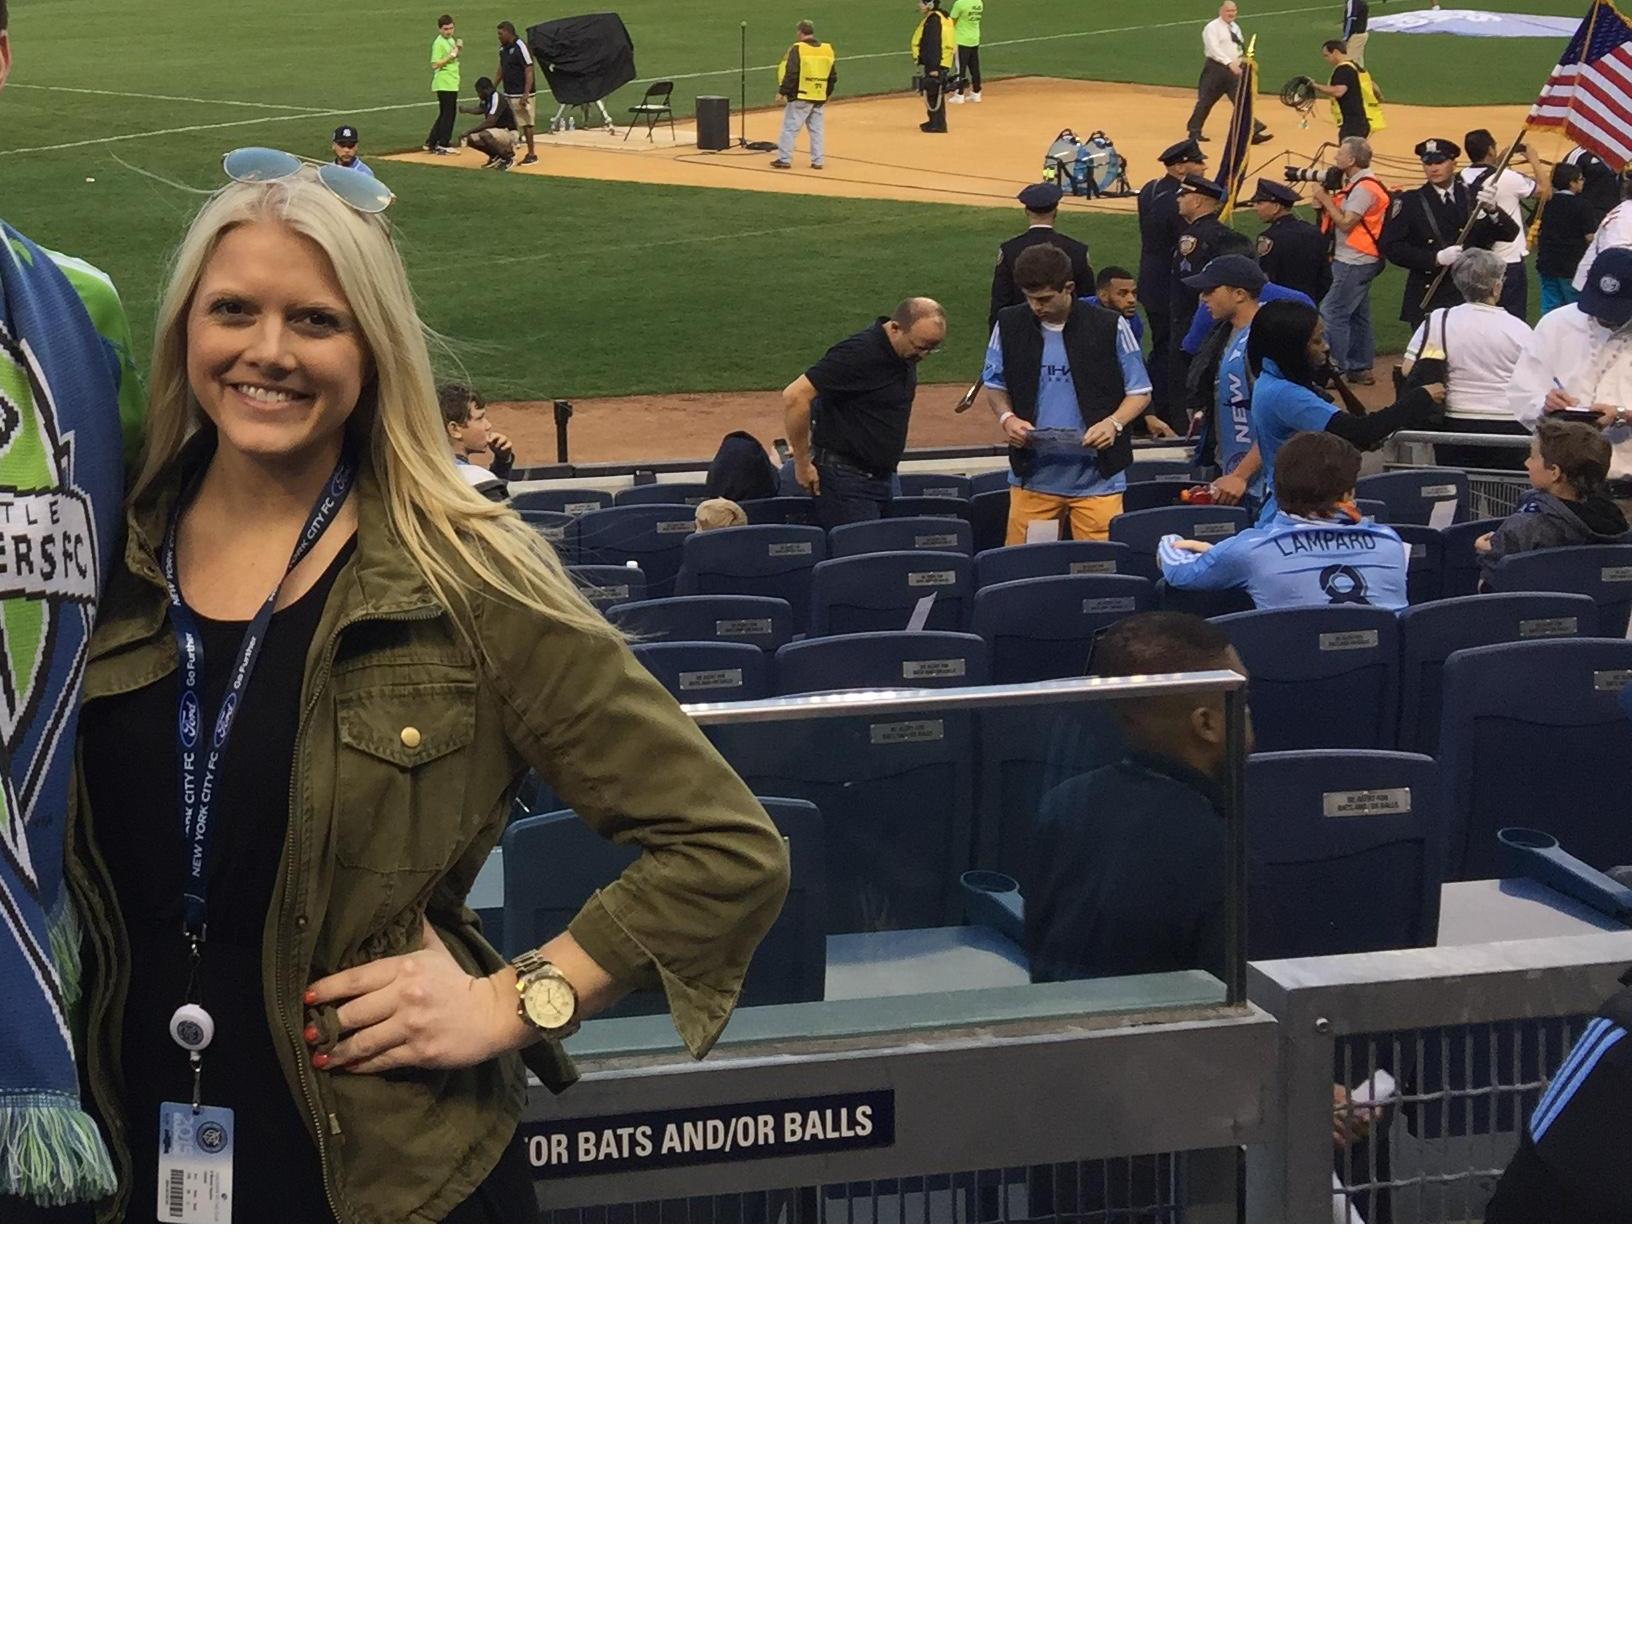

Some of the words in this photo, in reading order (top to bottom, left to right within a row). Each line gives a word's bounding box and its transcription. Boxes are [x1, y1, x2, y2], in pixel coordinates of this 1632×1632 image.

[1227, 372, 1252, 444] NEW
[306, 512, 326, 541] CITY
[1274, 532, 1377, 557] LAMPARD
[185, 632, 196, 670] Further
[238, 635, 257, 674] Further
[186, 670, 196, 687] Go
[233, 673, 244, 690] Go
[182, 700, 197, 737] Ford
[183, 752, 196, 770] FC
[208, 751, 219, 770] FC
[183, 772, 196, 804] CITY
[201, 770, 214, 803] CITY
[194, 804, 209, 841] YORK
[191, 843, 204, 878] NEW
[529, 1134, 569, 1167] OR
[578, 1125, 653, 1163] BATS
[661, 1114, 775, 1154] AND/OR
[784, 1105, 874, 1143] BALLS
